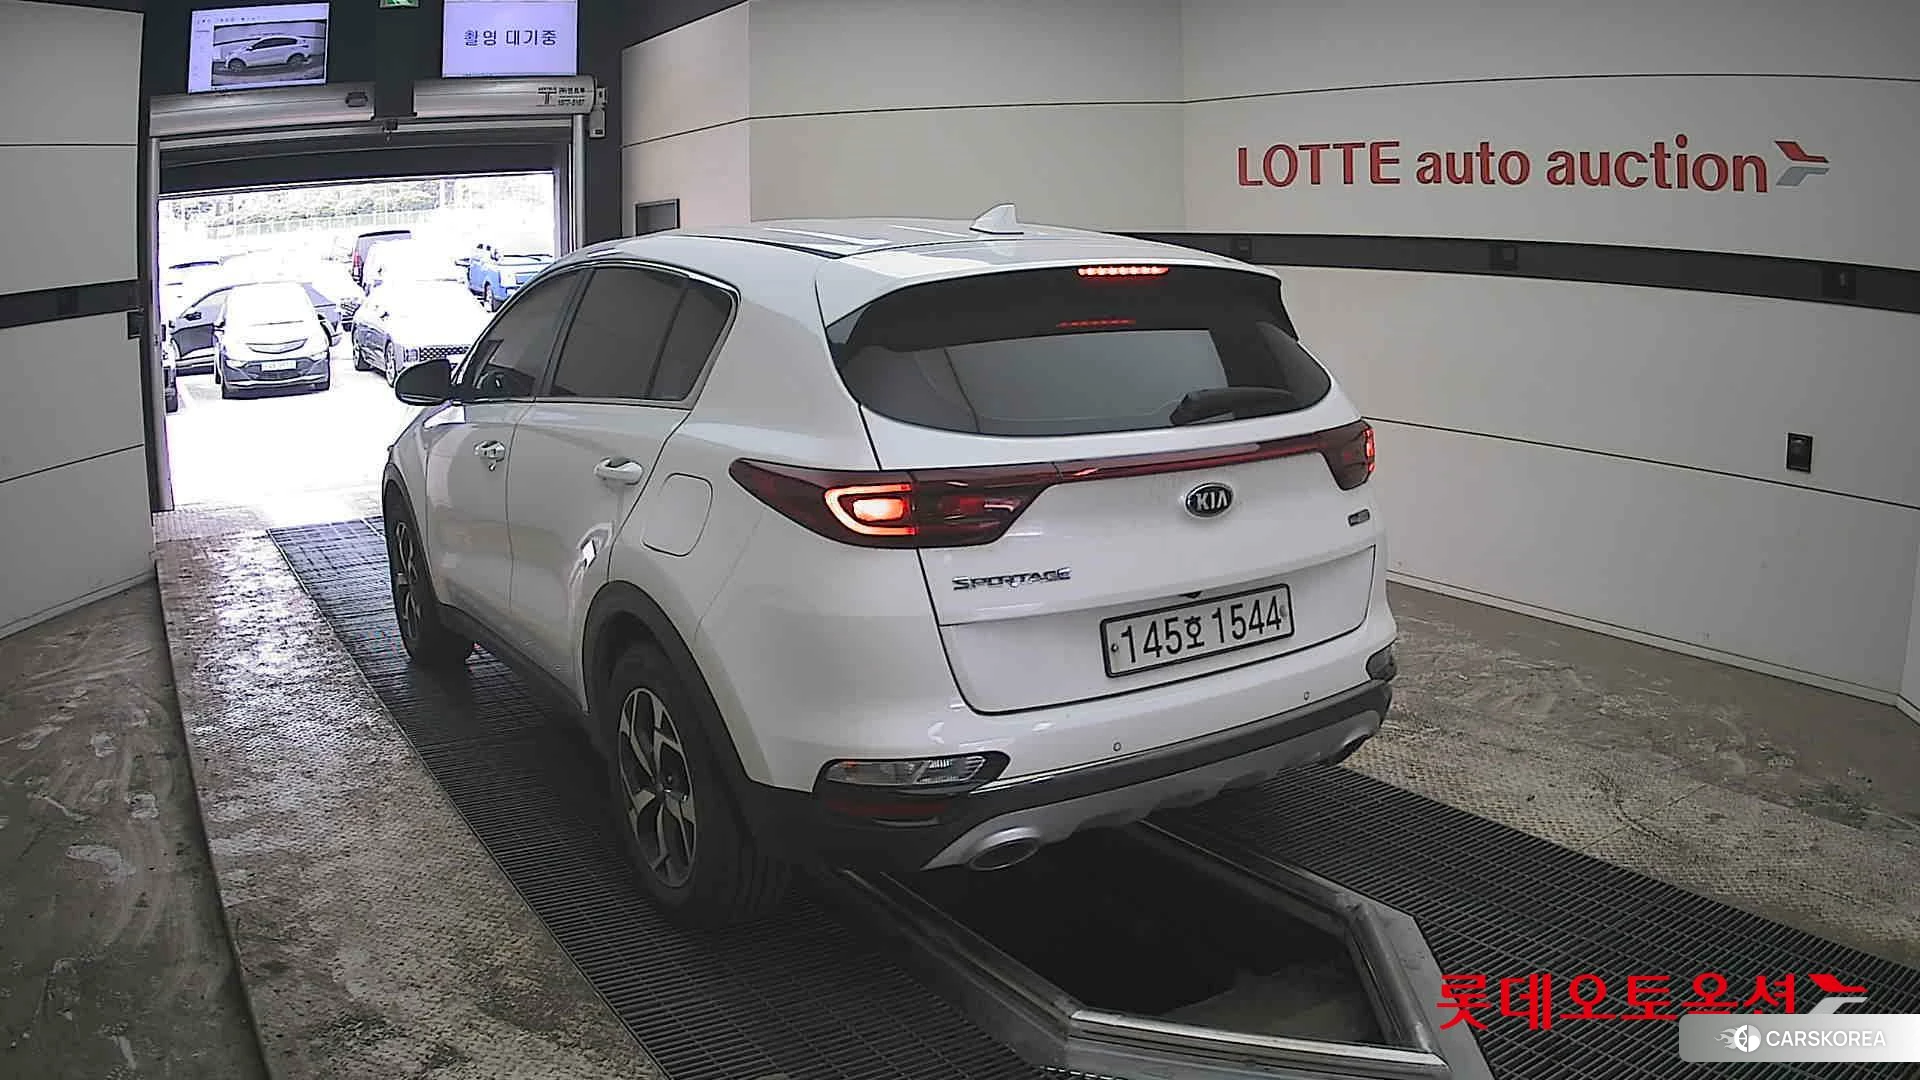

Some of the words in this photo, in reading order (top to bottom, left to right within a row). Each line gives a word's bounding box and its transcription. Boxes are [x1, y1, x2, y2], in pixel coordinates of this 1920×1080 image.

[505, 30, 556, 46] 대기중
[1238, 141, 1400, 187] LOTTE
[1416, 142, 1530, 185] auto
[1546, 134, 1767, 193] auction
[1195, 490, 1228, 510] KIA
[952, 568, 1071, 590] SPORTAGE
[1121, 616, 1204, 663] 145호
[1212, 596, 1282, 643] 1544
